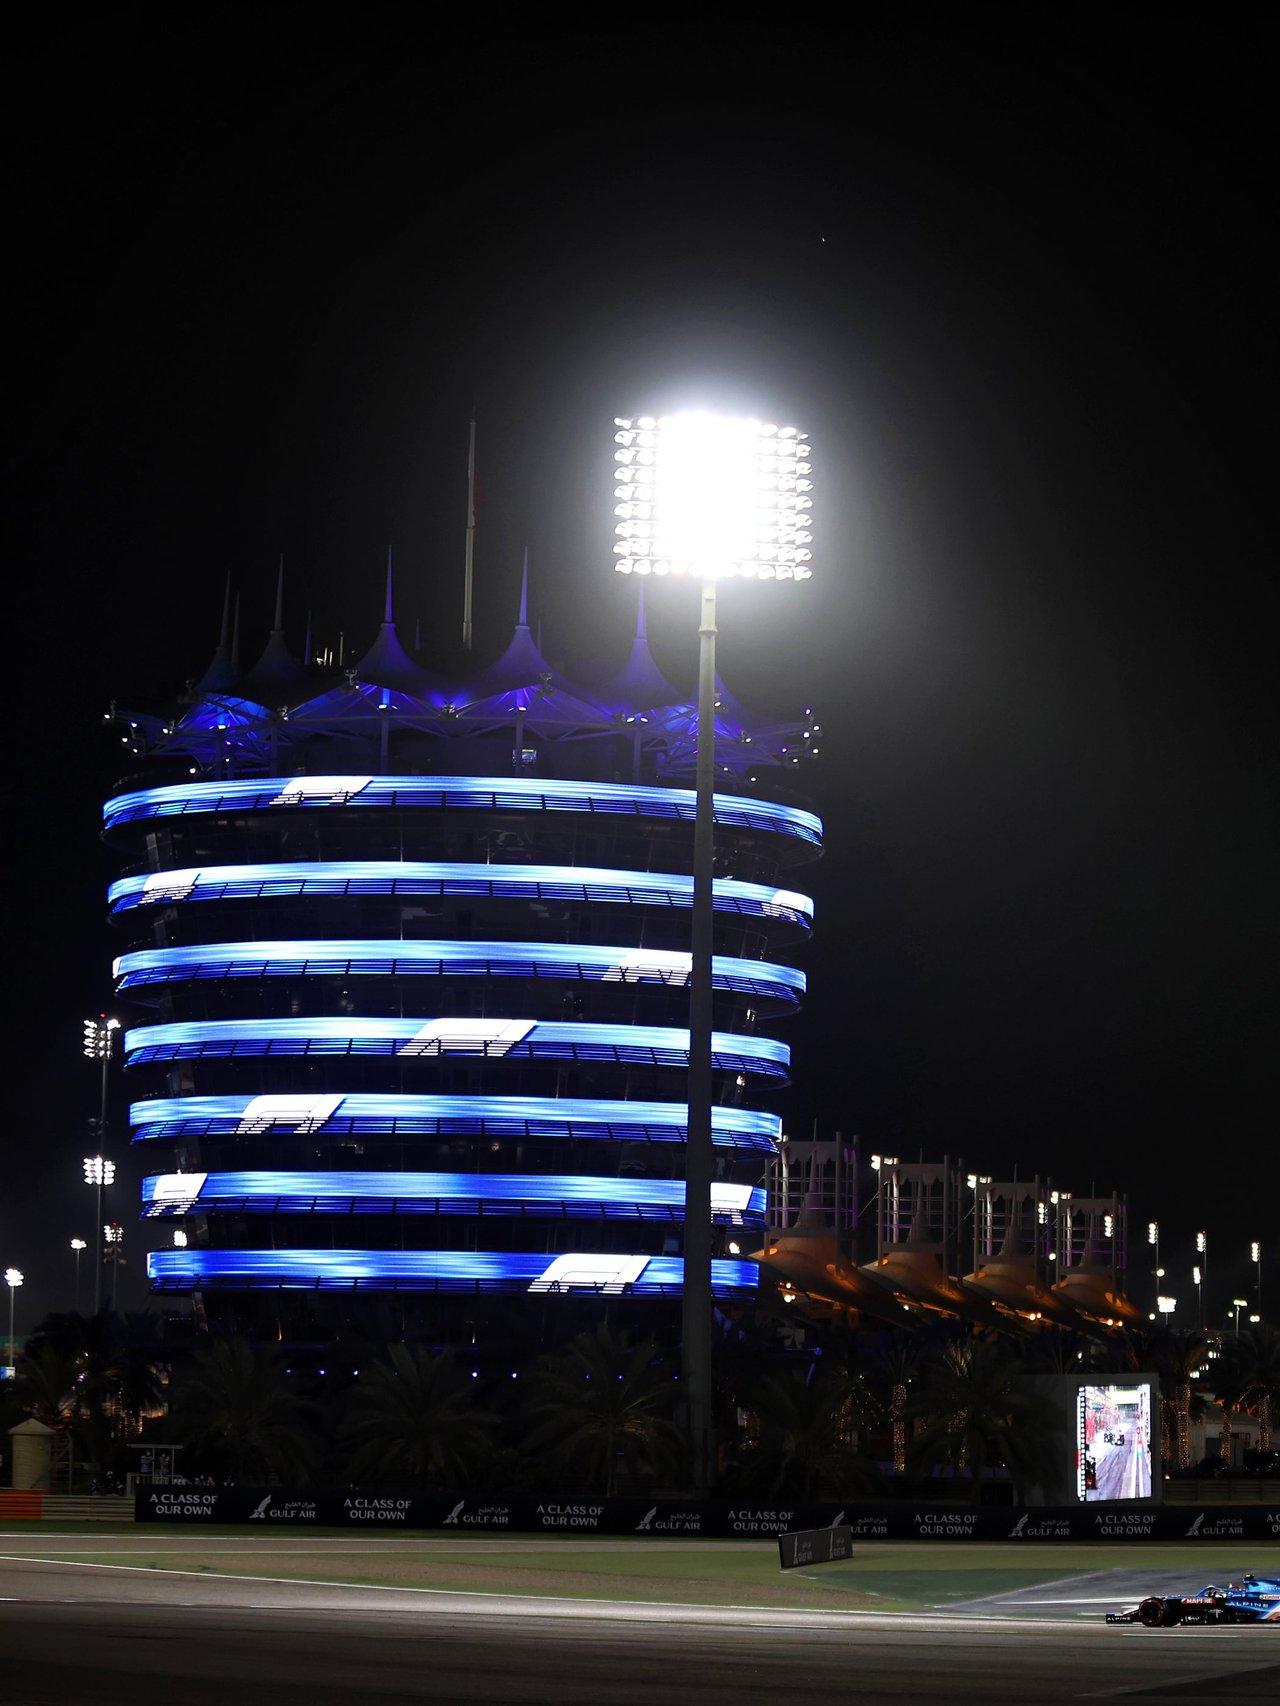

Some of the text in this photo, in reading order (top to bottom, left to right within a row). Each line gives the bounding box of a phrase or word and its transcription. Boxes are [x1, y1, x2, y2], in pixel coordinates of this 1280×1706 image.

[150, 1494, 218, 1504] A CLASS OF
[344, 1499, 412, 1509] A CLASS OF
[155, 1504, 211, 1515] OUR OWN
[270, 1510, 316, 1518] GULF AIR
[536, 1505, 604, 1515] A CLASS OF
[349, 1509, 405, 1520] OUR OWN
[728, 1511, 794, 1520] A CLASS OF
[914, 1515, 978, 1523] A CLASS OF
[1095, 1514, 1157, 1524] A CLASS OF
[1266, 1514, 1274, 1522] A
[463, 1515, 508, 1524] GULF AIR
[542, 1516, 598, 1526] OUR OWN
[655, 1521, 700, 1529] GULF AIR
[734, 1522, 788, 1531] OUR OWN
[851, 1525, 887, 1534] ULF AIR
[920, 1526, 972, 1534] OUR OWN
[1027, 1528, 1070, 1536] GULF AIR
[1101, 1525, 1151, 1535] OUR OWN
[1203, 1527, 1243, 1535] GULF AIR
